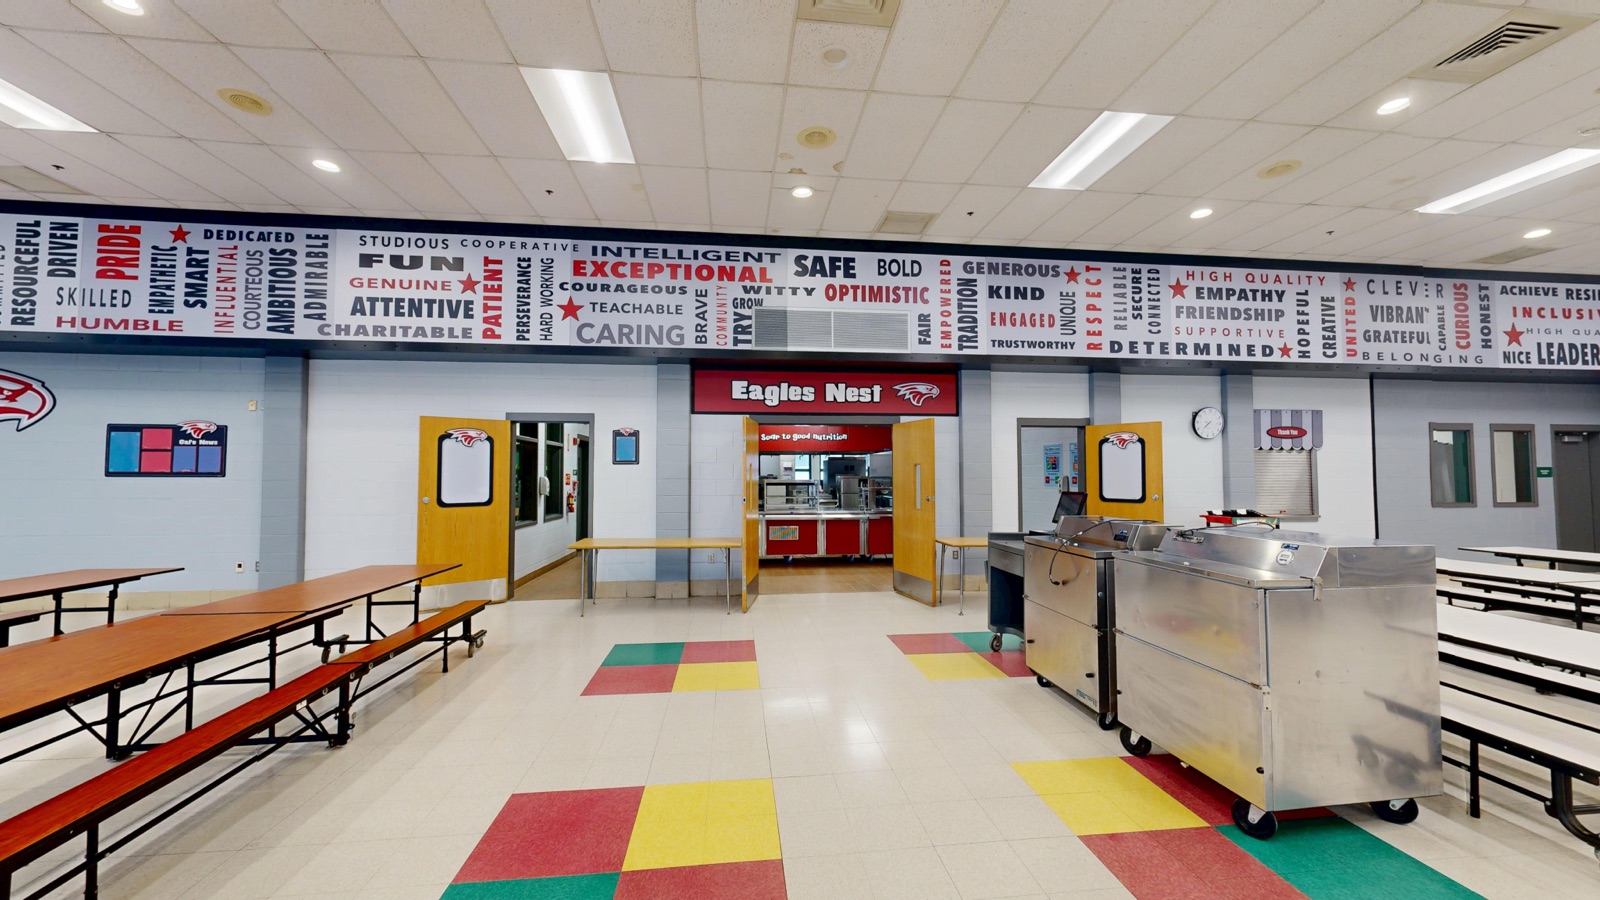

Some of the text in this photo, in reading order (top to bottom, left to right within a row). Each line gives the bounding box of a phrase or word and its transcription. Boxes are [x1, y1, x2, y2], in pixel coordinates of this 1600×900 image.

[204, 229, 295, 242] DEDICATED
[359, 235, 449, 250] STUDIOUS
[460, 238, 578, 252] COOPERATIVE
[47, 222, 79, 278] DRIVEN
[96, 224, 142, 280] PRIDE
[592, 246, 781, 263] INTELLIGENT
[10, 220, 41, 326] RESOURCEFUL
[359, 253, 464, 272] FUN
[572, 260, 772, 283] EXCEPTIONAL
[794, 255, 856, 278] SAFE
[878, 259, 922, 277] BOLD
[962, 261, 1060, 278] GENEROUS
[148, 245, 178, 314] EMPATHETIC
[183, 246, 210, 309] SMART
[214, 245, 238, 333] INFLUENTIAL
[304, 234, 328, 321] ADMIRABLE
[350, 277, 452, 291] GENUINE
[559, 282, 688, 295] COURAGEOUS
[1186, 270, 1325, 286] HIGH QUALITY
[56, 286, 132, 308] SKILLED
[242, 250, 264, 330] COURTEOUS
[266, 248, 298, 334] AMBITIOUS
[482, 256, 503, 339] PATIENT
[516, 257, 531, 341] PERSEVERANCE
[540, 258, 554, 341] HARD WORKING
[742, 285, 816, 296] WITTY
[824, 284, 930, 304] OPTIMISTIC
[988, 285, 1044, 300] KIND
[1113, 266, 1128, 331] RELIABLE
[1131, 268, 1142, 320] SECURE
[1147, 268, 1161, 334] CONNECTED
[1196, 287, 1286, 302] EMPATHY
[1500, 285, 1558, 297] ACHIEVE
[350, 296, 474, 319] ATTENTIVE
[590, 302, 683, 314] TEACHABLE
[732, 297, 764, 310] GROW
[940, 259, 952, 348] EMPOWERED
[956, 278, 978, 351] TRADITION
[1060, 292, 1076, 335] UNIQUE
[1086, 265, 1102, 351] RESPECT
[1175, 306, 1285, 322] FRIENDSHIP
[1370, 305, 1429, 324] VIBRAN
[56, 316, 184, 332] HUMBLE
[695, 288, 708, 344] BRAVE
[716, 285, 728, 346] COMMUNITY
[991, 312, 1055, 328] ENGAGED
[1296, 289, 1311, 358] HOPEFUL
[1345, 296, 1358, 358] UNITED
[1453, 282, 1471, 350] CURIOUS
[1478, 283, 1492, 349] HONEST
[318, 323, 472, 339] CHARITABLE
[576, 322, 684, 346] CARING
[732, 312, 752, 346] TRY
[918, 313, 931, 345] FAIR
[1175, 326, 1284, 338] SUPPORTIVE
[1320, 296, 1337, 359] CREATIVE
[1436, 304, 1447, 351] CAPABLE
[991, 339, 1075, 350] TRUSTWORTHY
[1109, 340, 1274, 357] DETERMINED
[1362, 352, 1484, 364] BELONGING
[1503, 351, 1532, 364] NICE
[732, 380, 882, 406] Eagles Nest
[792, 432, 810, 441] good
[813, 433, 847, 441] nutrition
